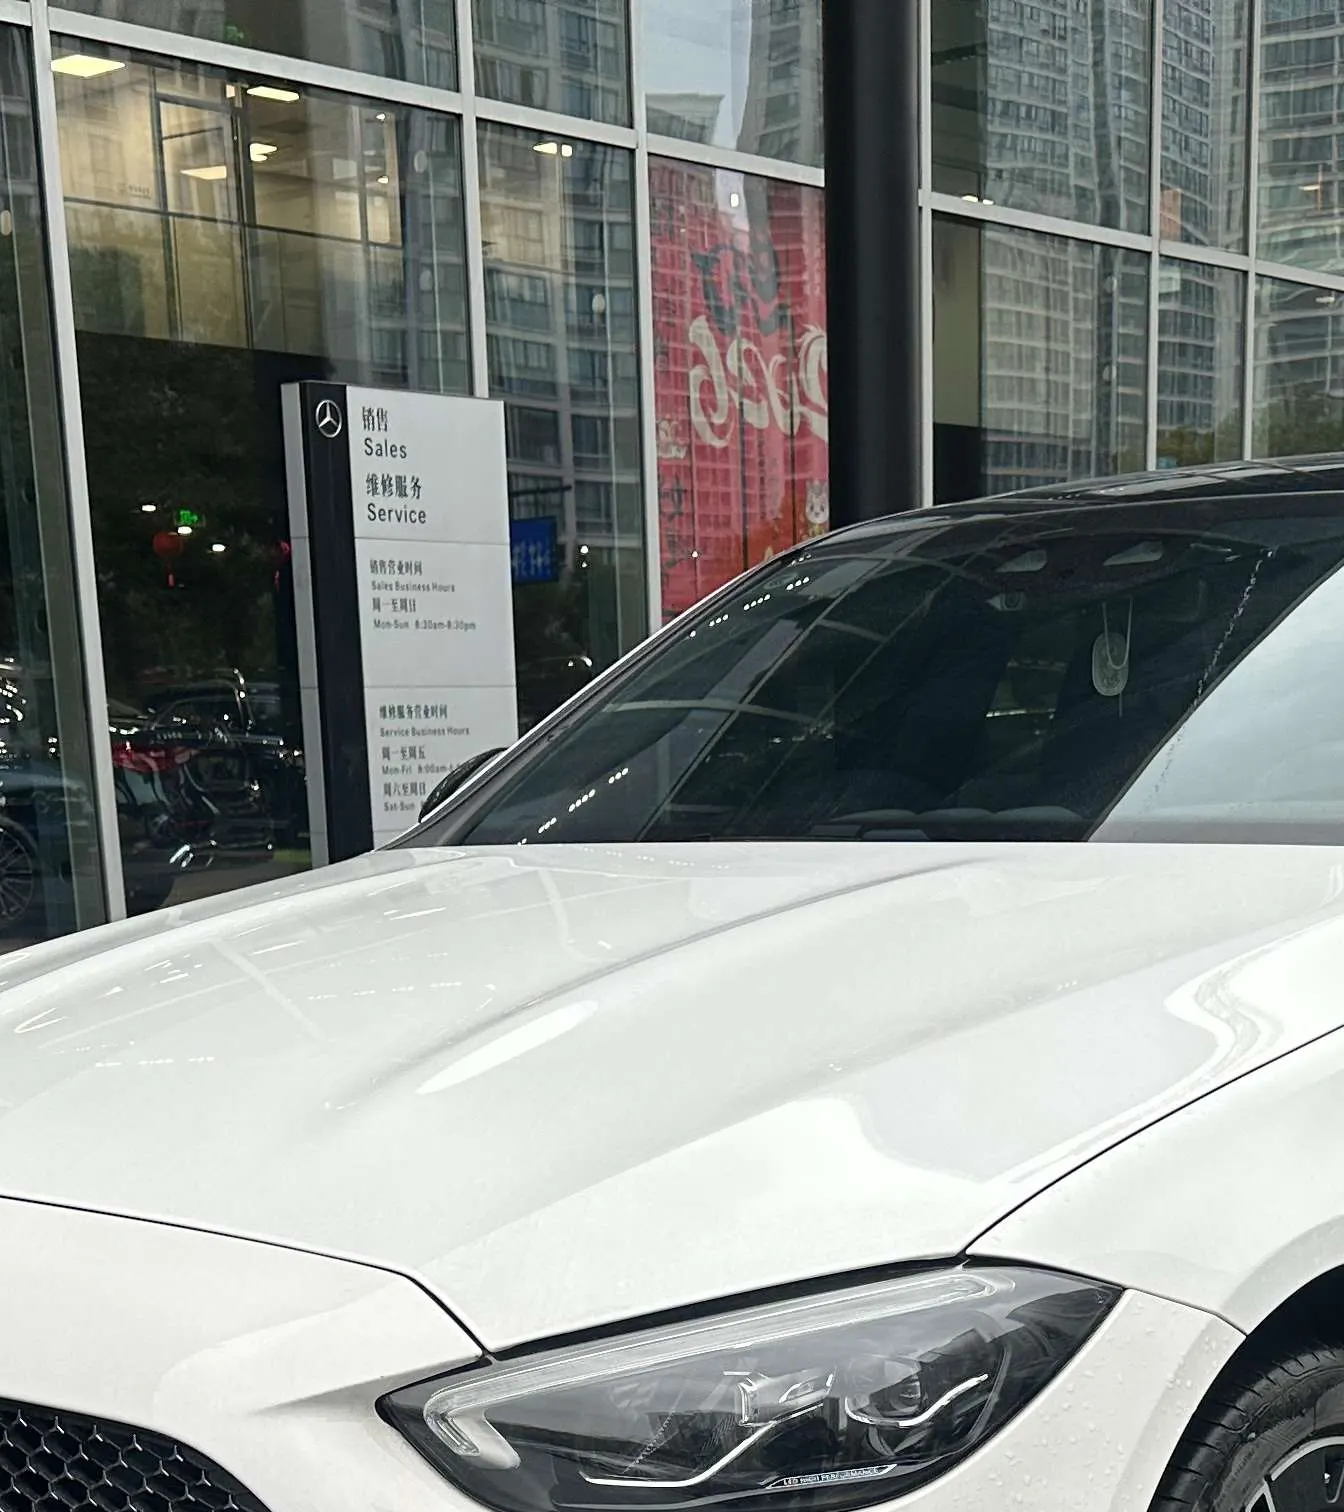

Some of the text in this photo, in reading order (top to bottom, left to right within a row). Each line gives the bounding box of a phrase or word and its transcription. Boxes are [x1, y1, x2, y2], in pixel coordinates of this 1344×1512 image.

[362, 406, 388, 432] 销售
[364, 438, 407, 458] Sales
[366, 473, 422, 499] 维修服务
[367, 503, 427, 524] Service
[372, 580, 393, 591] Sales
